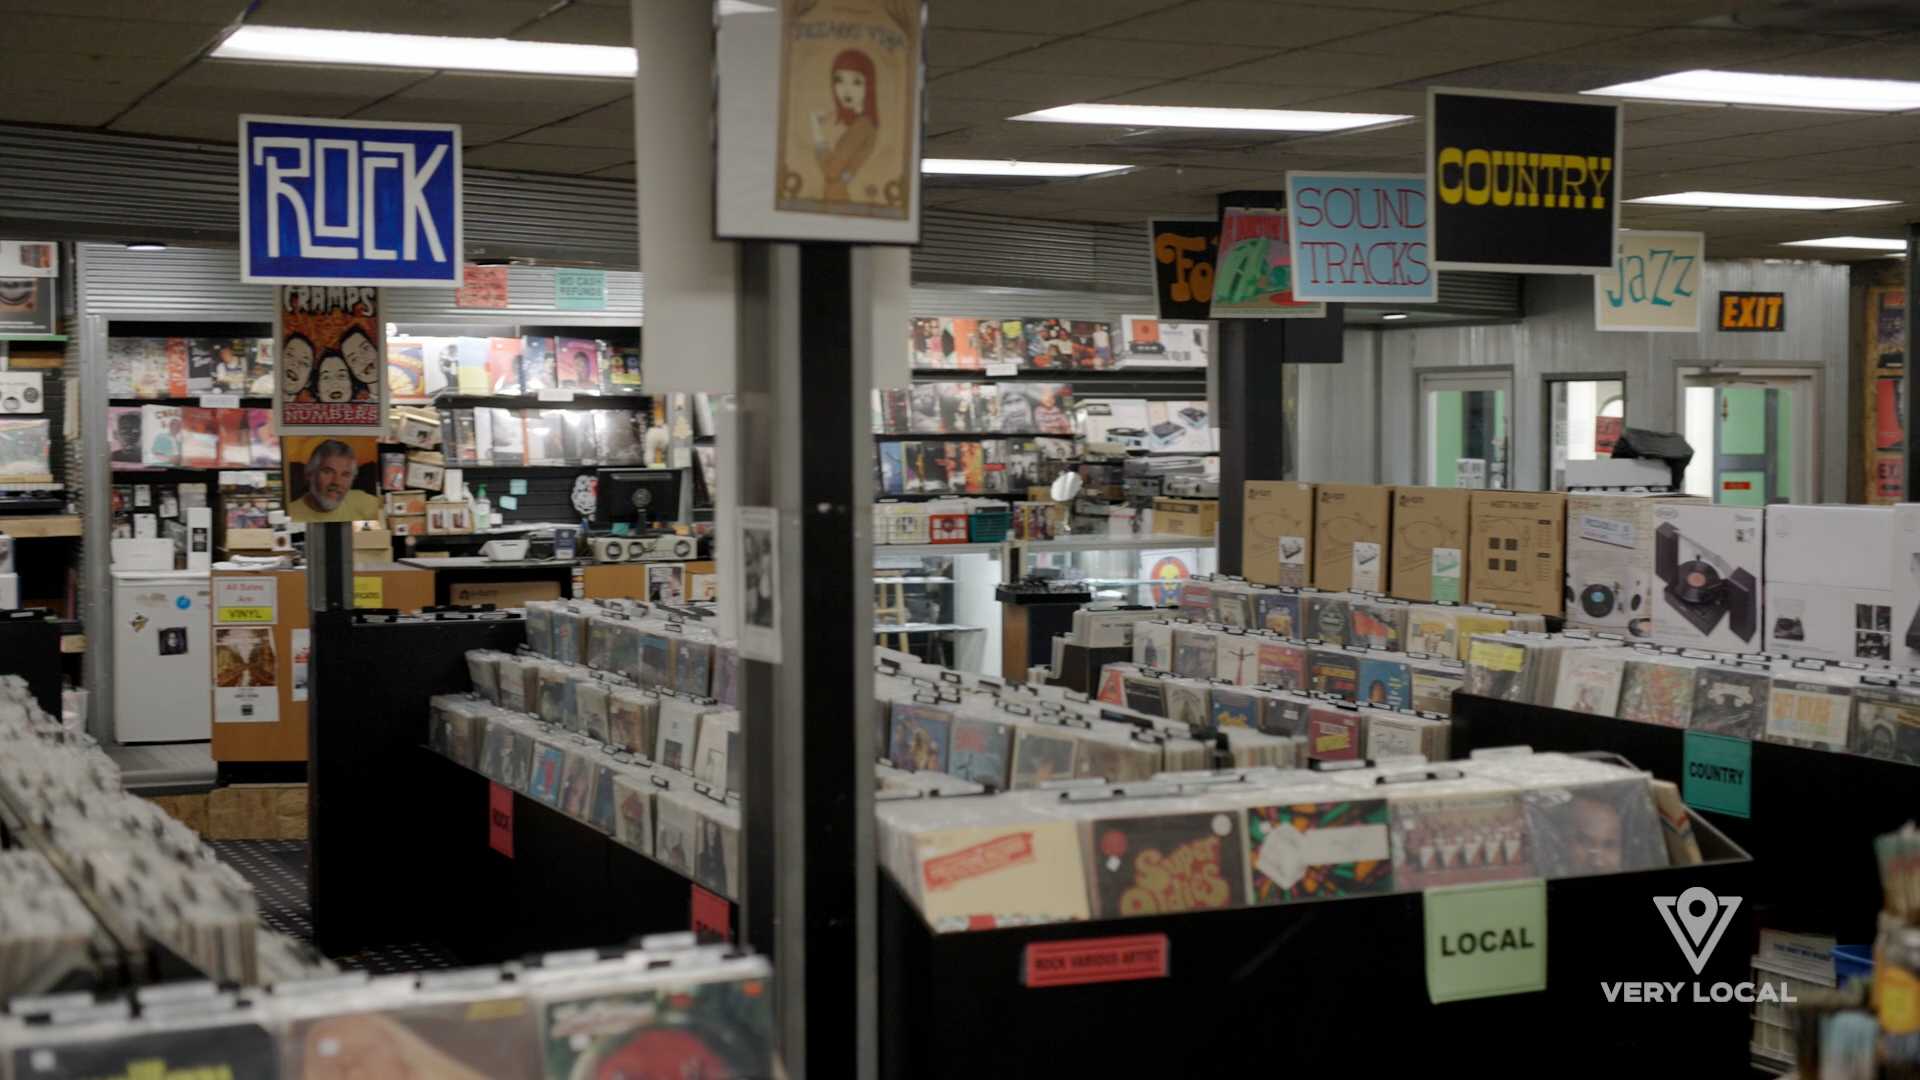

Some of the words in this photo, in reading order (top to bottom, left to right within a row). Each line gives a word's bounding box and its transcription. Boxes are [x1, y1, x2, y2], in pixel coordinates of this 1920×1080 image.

[1439, 147, 1612, 209] COUNTRY
[253, 136, 448, 262] ROCK
[1296, 187, 1427, 229] SOUND
[1301, 241, 1430, 285] TRACKS
[284, 286, 375, 316] CRAMPS
[1722, 296, 1782, 328] EXIT
[1689, 762, 1745, 785] COUNTRY
[1441, 928, 1535, 957] LOCAL
